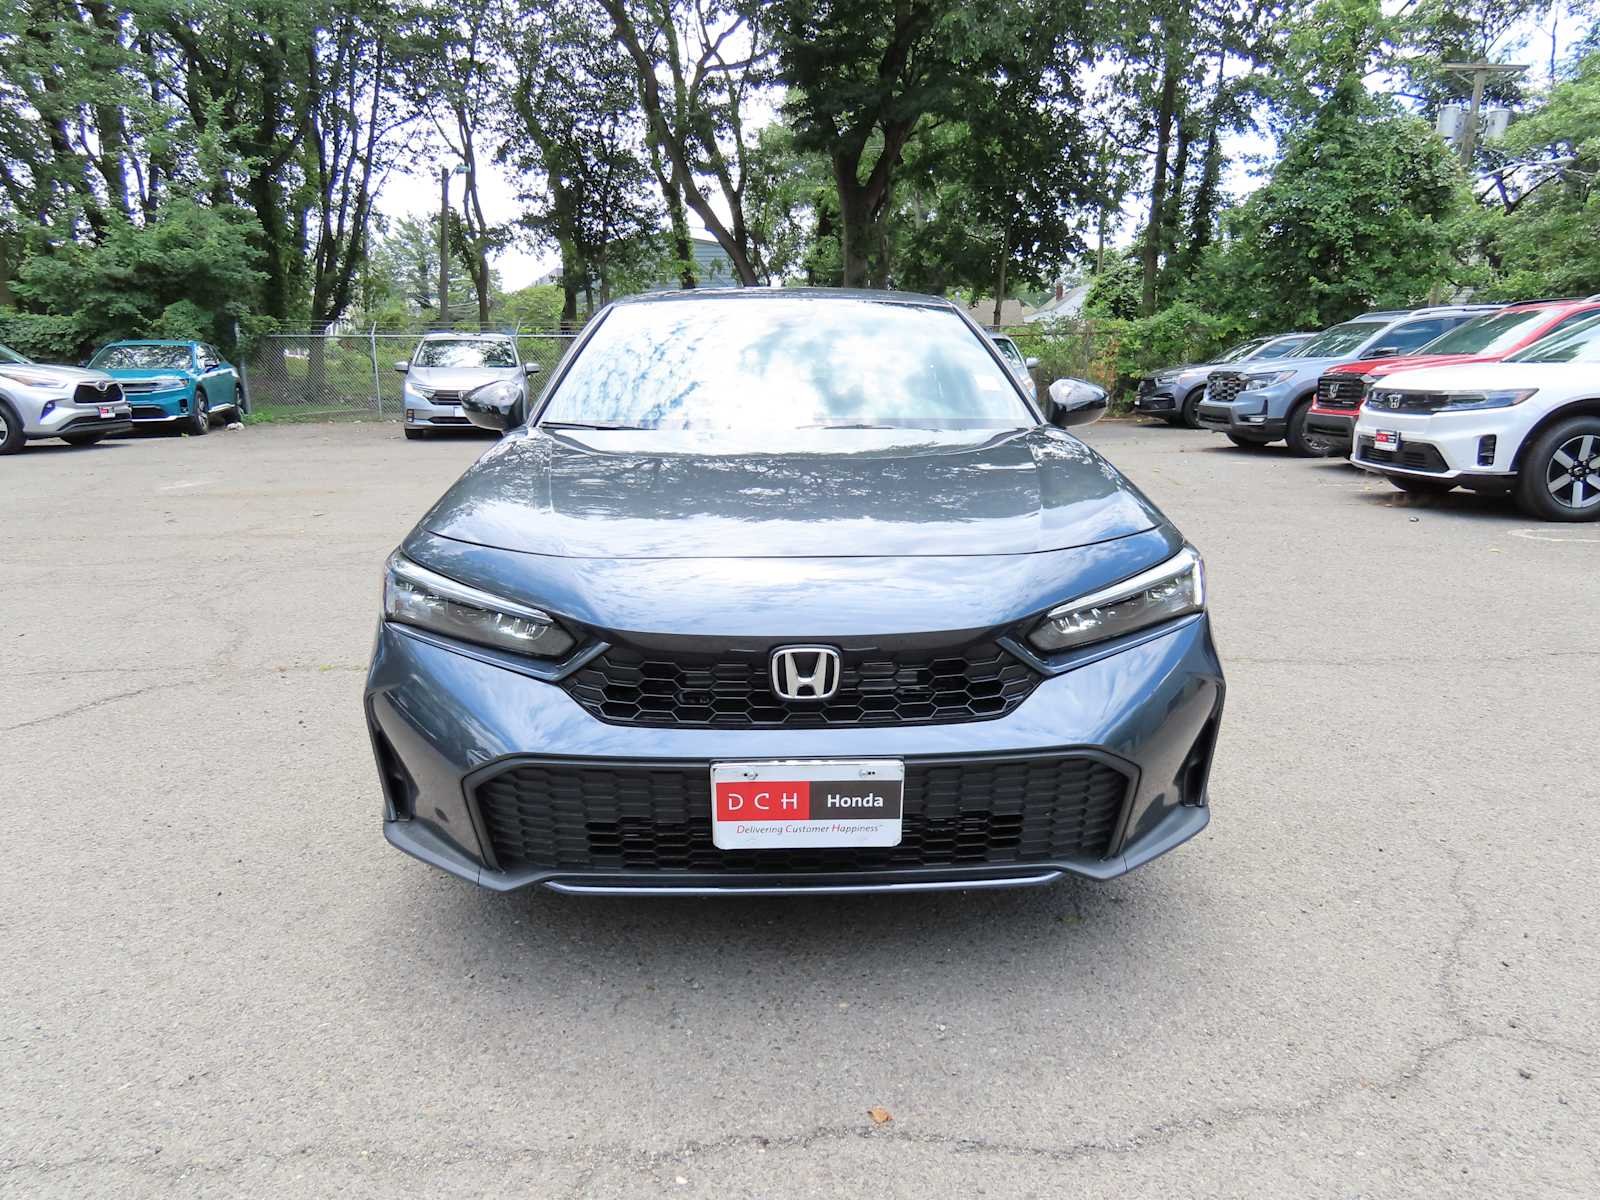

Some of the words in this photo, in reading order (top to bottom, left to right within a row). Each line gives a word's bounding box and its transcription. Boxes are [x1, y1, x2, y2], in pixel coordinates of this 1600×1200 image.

[827, 793, 884, 808] Honda
[736, 824, 783, 836] Delivering
[785, 824, 829, 833] Customer
[831, 823, 879, 835] Happiness
